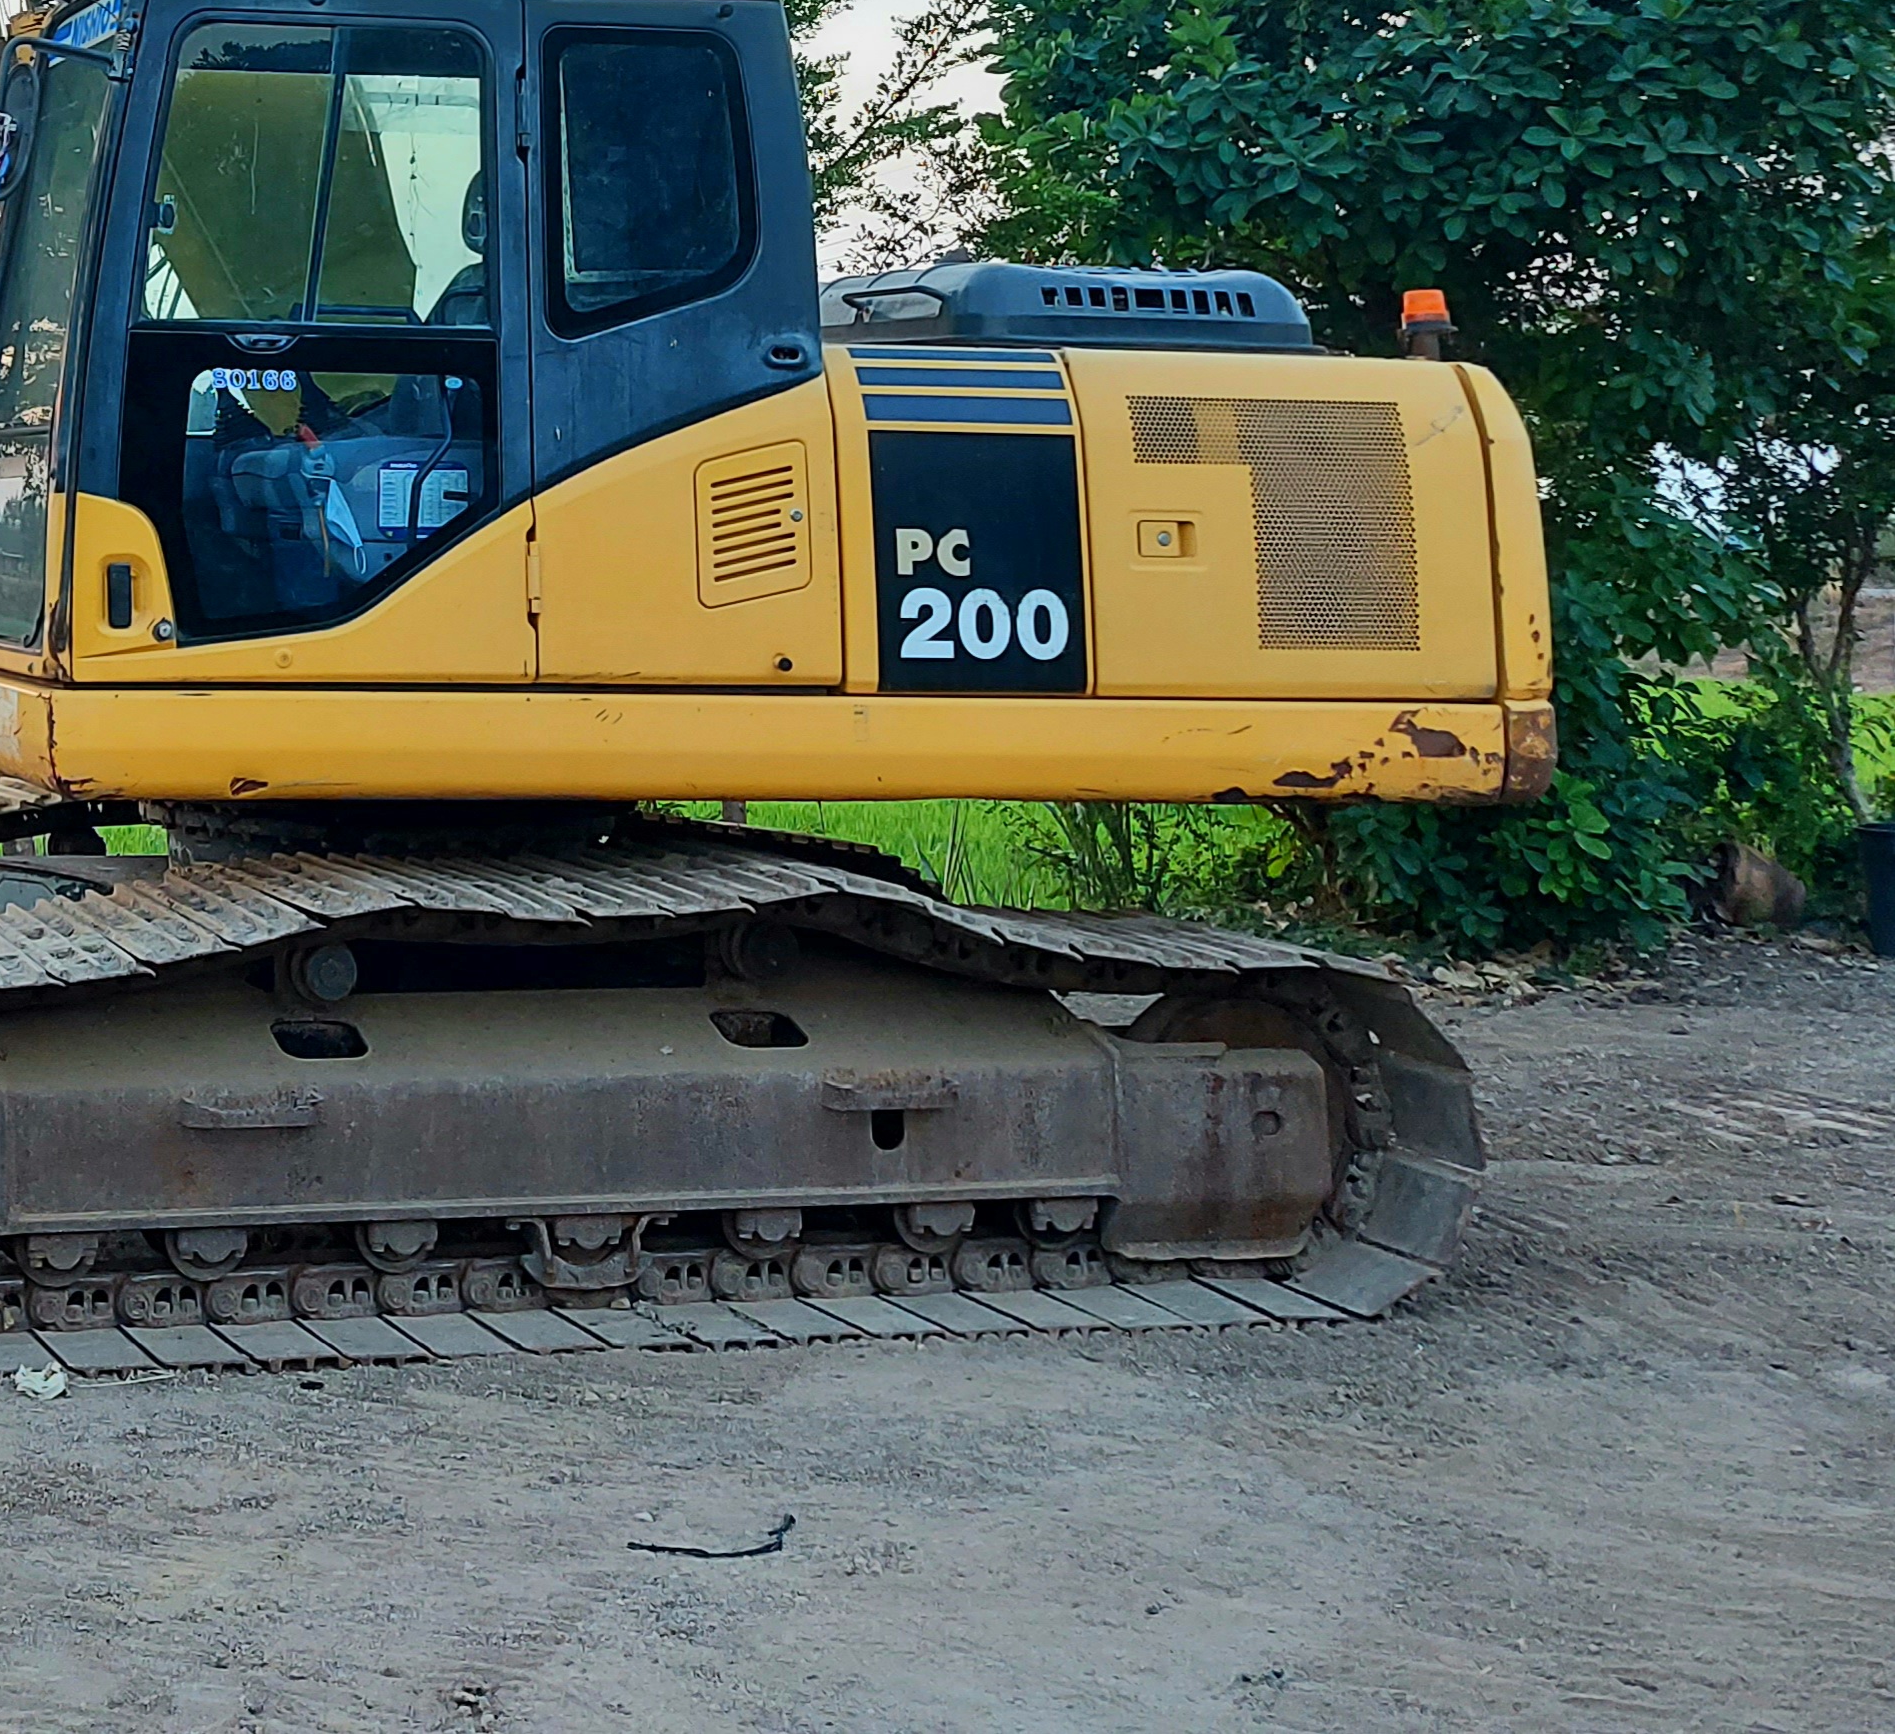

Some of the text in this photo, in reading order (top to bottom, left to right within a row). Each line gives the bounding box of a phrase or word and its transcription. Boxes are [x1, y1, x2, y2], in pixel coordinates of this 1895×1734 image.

[211, 368, 296, 390] 80166
[896, 528, 970, 576] PC
[900, 587, 1069, 660] 200
